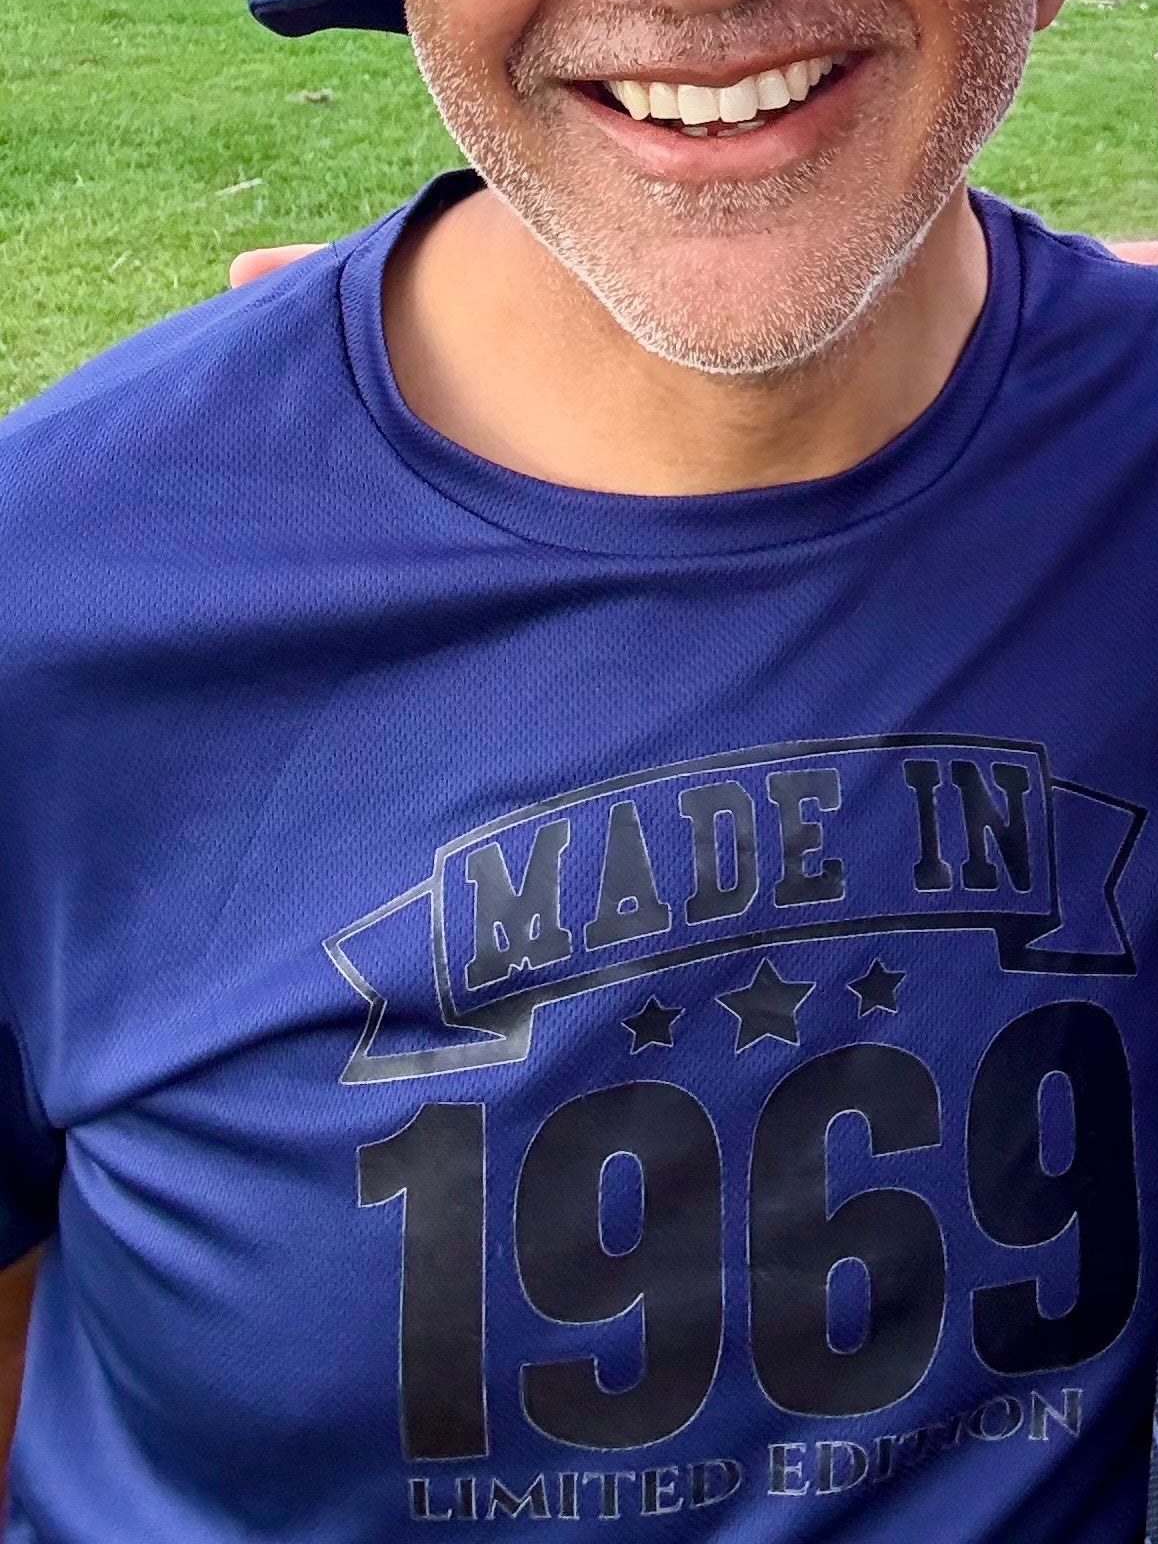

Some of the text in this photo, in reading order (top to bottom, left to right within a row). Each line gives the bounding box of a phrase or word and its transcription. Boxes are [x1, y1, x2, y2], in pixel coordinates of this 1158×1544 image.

[463, 759, 1034, 991] MADE IN
[356, 999, 1142, 1461] 1969
[408, 1458, 741, 1522] LIMITED
